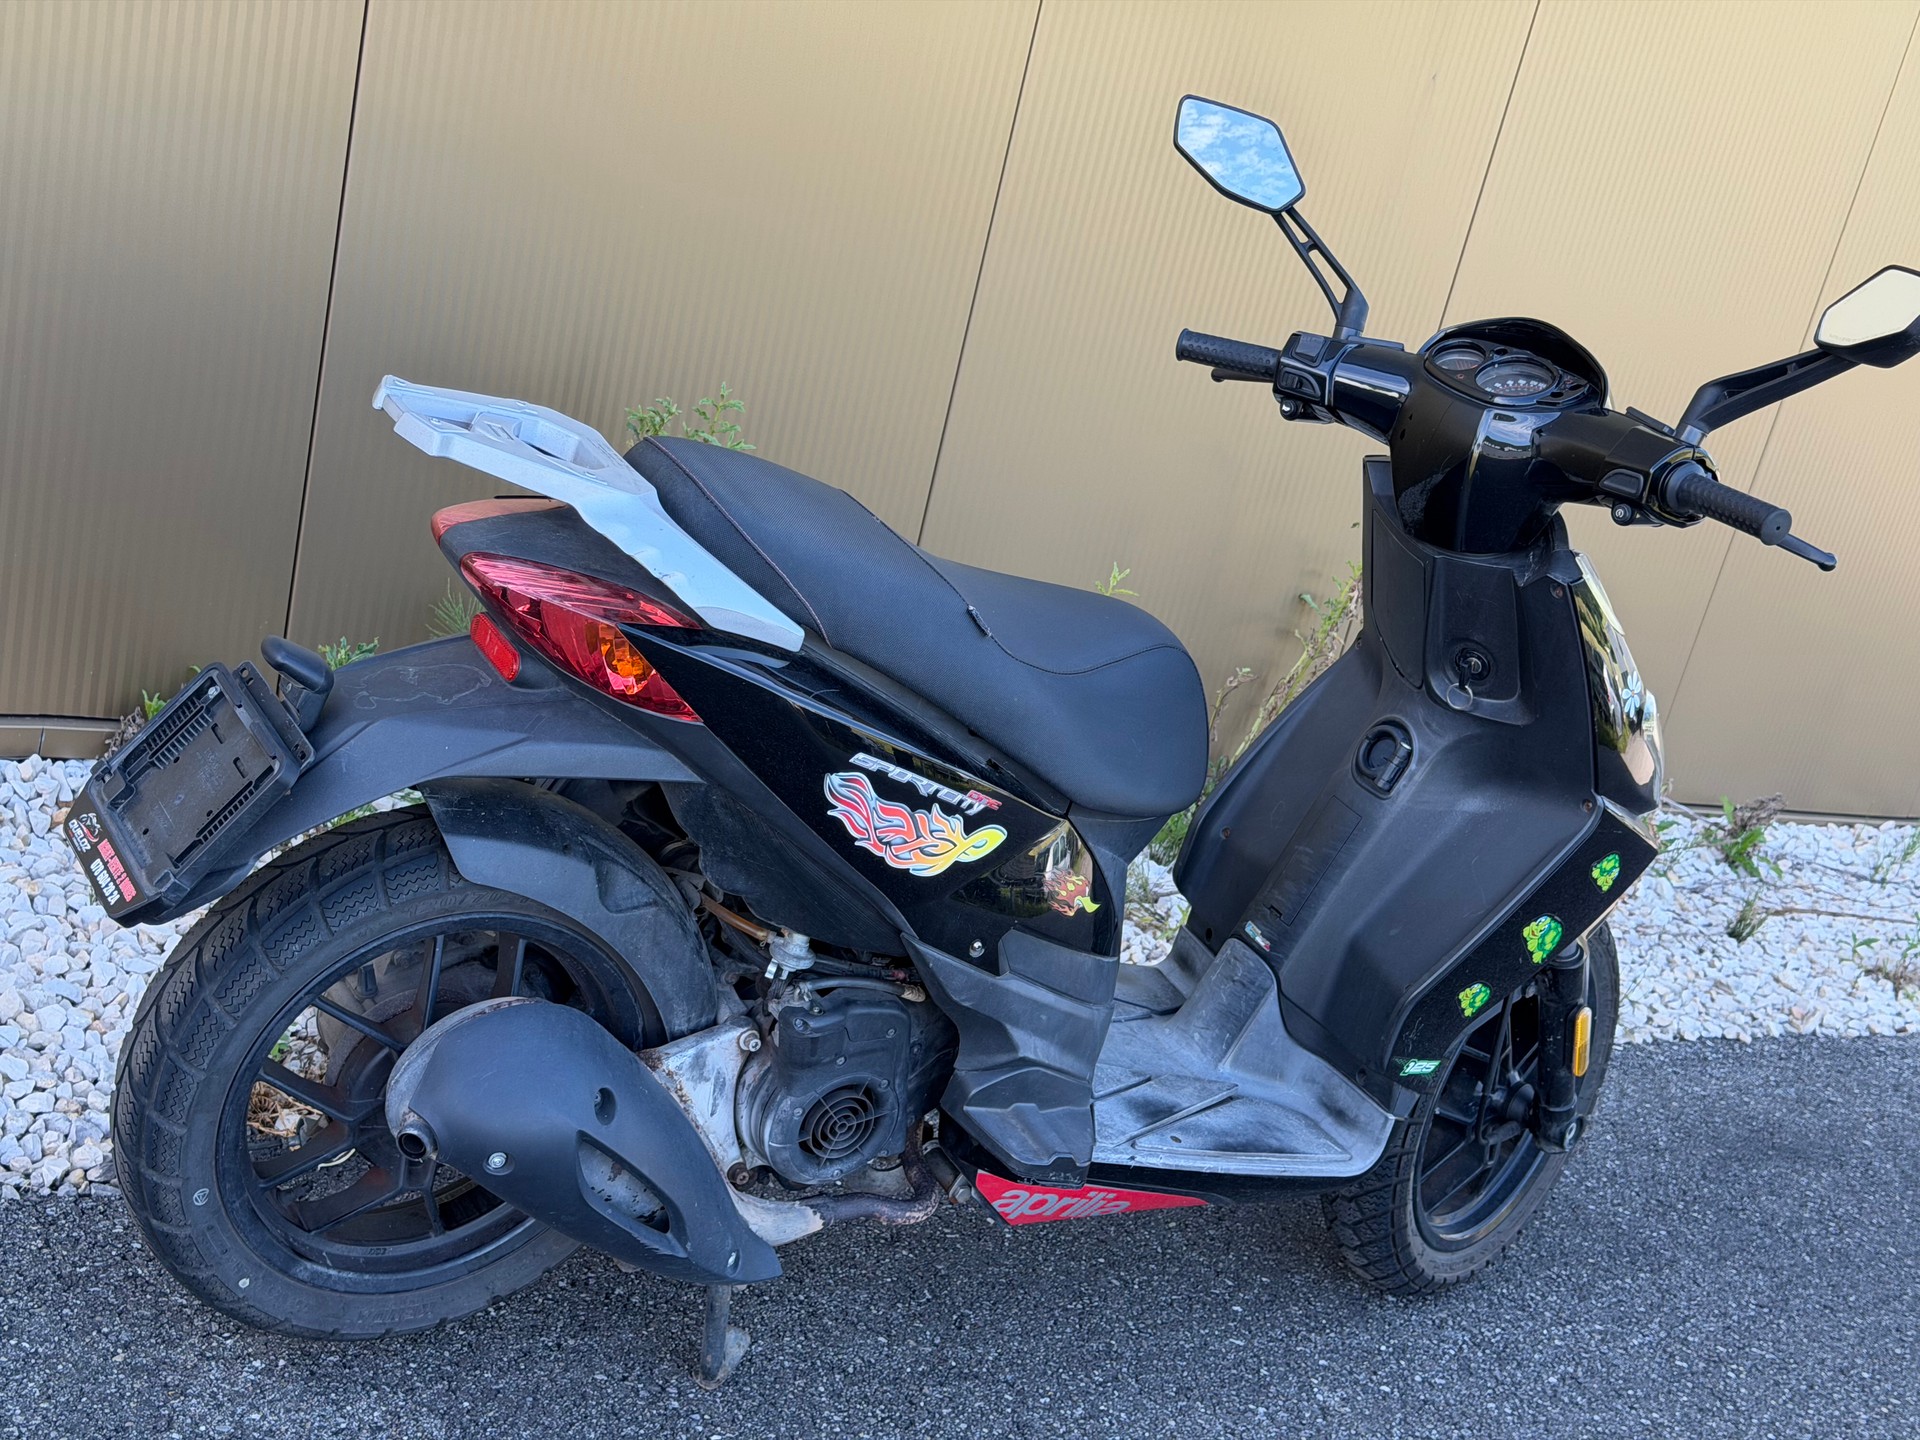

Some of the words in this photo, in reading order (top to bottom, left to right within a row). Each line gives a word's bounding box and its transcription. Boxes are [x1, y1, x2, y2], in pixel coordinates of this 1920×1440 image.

[68, 819, 91, 853] QUELOZ
[90, 858, 104, 876] 078
[97, 870, 111, 888] 604
[103, 882, 116, 897] 28
[107, 890, 120, 906] 24
[1403, 1061, 1438, 1073] 125
[992, 1189, 1131, 1220] aprilia
